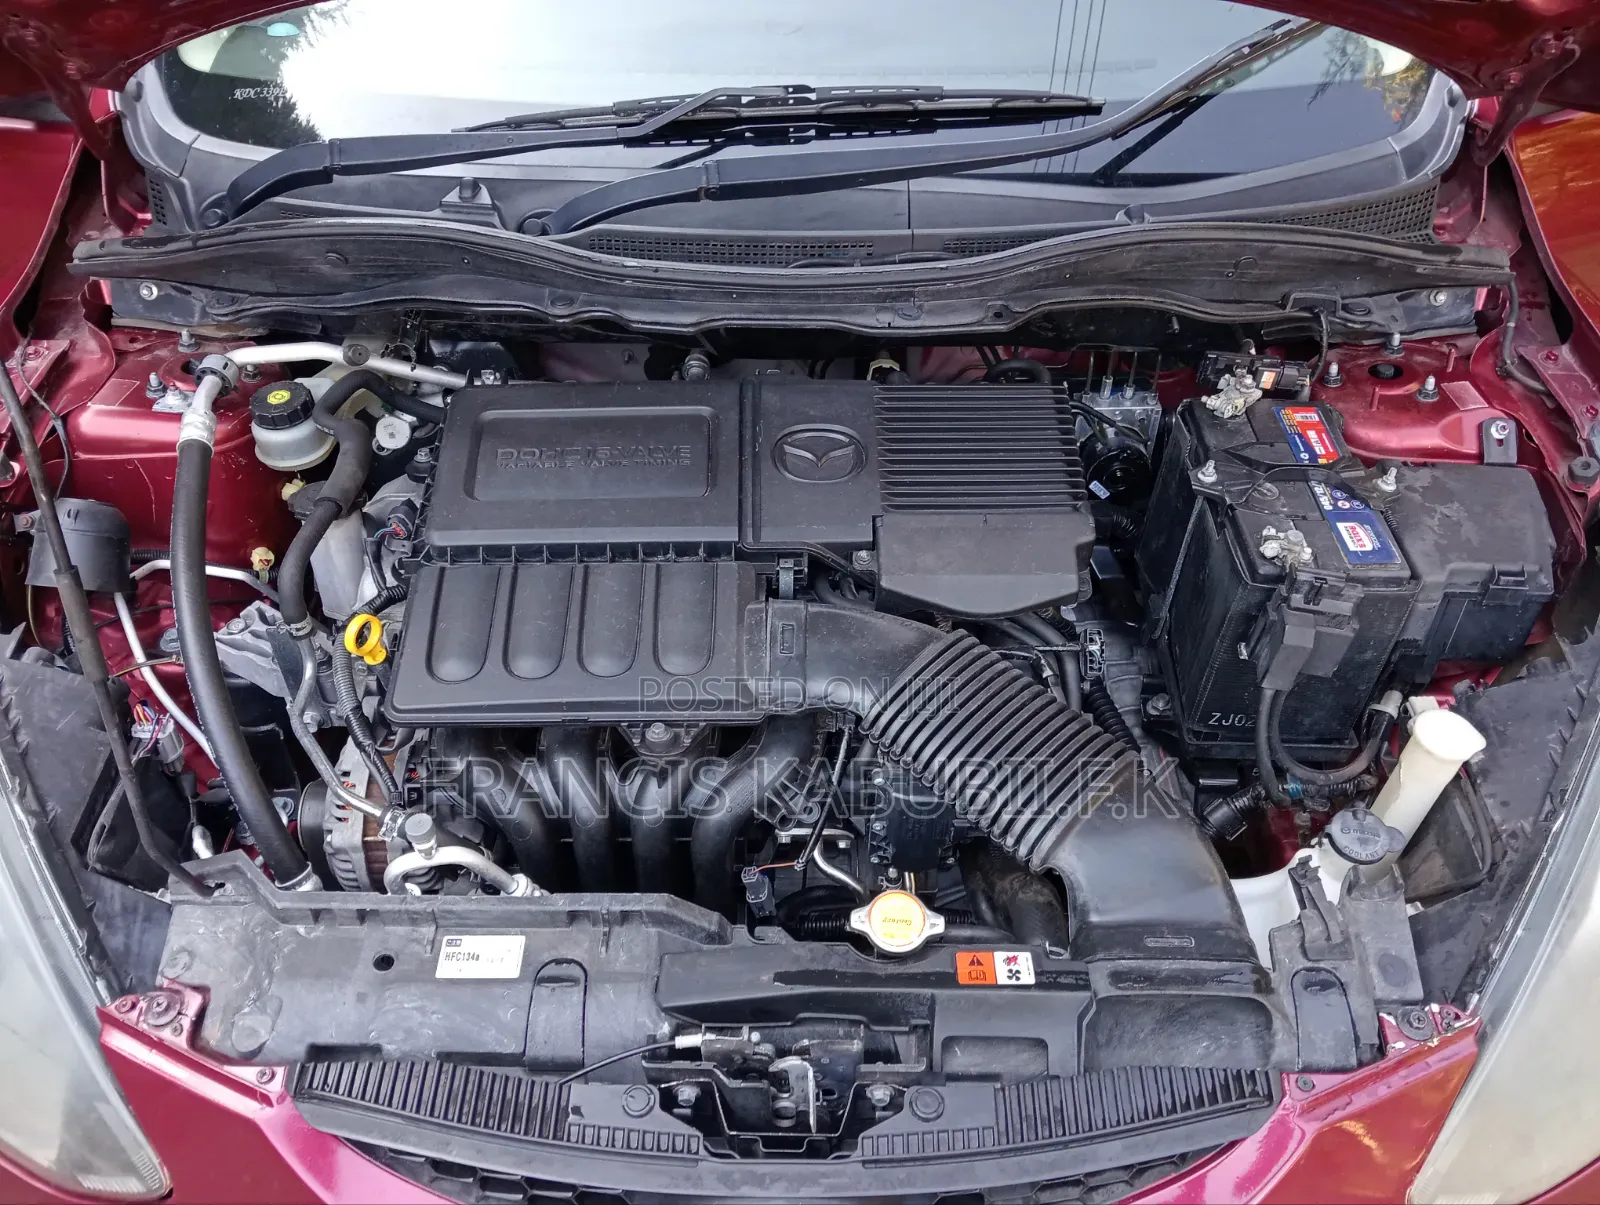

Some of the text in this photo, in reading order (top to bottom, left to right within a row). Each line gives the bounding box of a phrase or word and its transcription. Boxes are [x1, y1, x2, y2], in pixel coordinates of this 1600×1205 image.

[233, 88, 260, 100] KDC
[497, 447, 580, 460] DOHC
[497, 459, 691, 469] VARIABLE VALVE TIMING
[1348, 525, 1366, 549] EXIDE
[1343, 846, 1380, 860] COOLANT
[882, 917, 913, 926] Century
[444, 951, 480, 962] HFC134a
